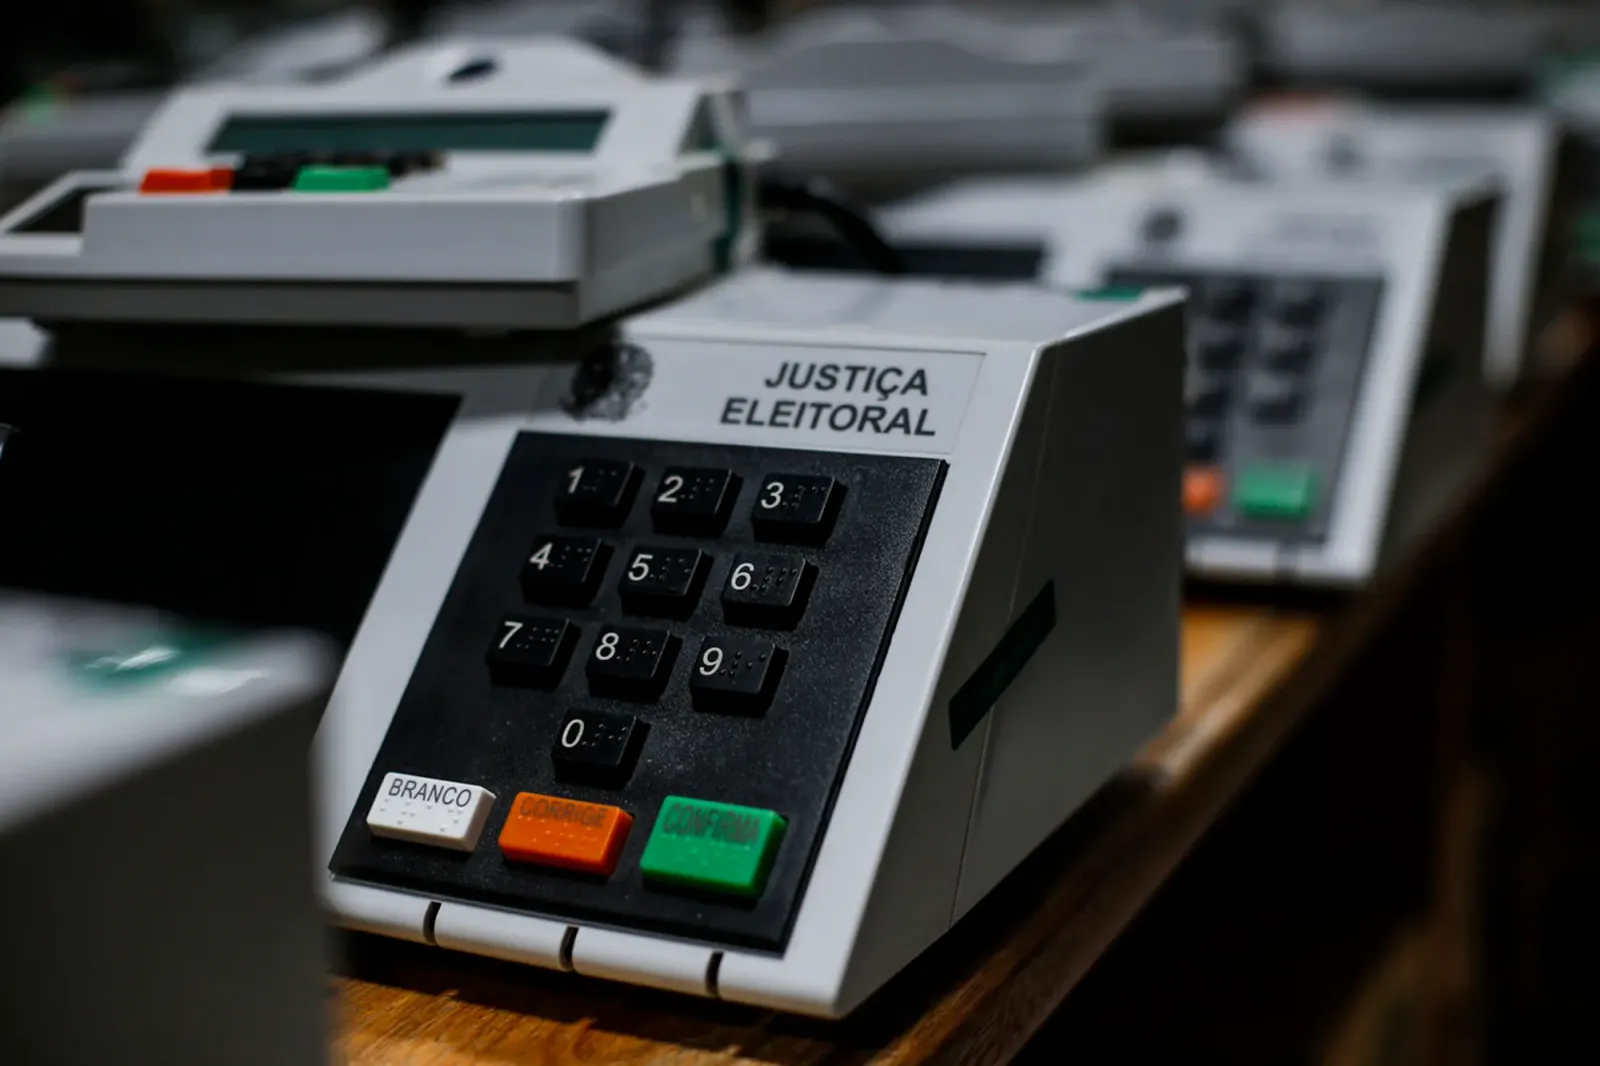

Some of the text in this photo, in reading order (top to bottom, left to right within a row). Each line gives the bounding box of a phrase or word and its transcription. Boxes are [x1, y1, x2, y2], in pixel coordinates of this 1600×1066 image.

[764, 361, 929, 400] JUSTIÇA
[720, 397, 937, 436] ELEITORAL
[568, 466, 585, 494] 1
[657, 475, 684, 503] 2
[760, 481, 785, 509] 3
[530, 542, 553, 570] 4
[627, 553, 653, 581] 5
[731, 562, 755, 590] 6
[498, 620, 523, 649] 7
[595, 632, 619, 661] 8
[699, 647, 724, 676] 9
[561, 718, 585, 748] 0
[388, 778, 472, 808] BRANCO
[519, 796, 606, 829] CORRIGE
[664, 803, 760, 845] CONFIRMA
